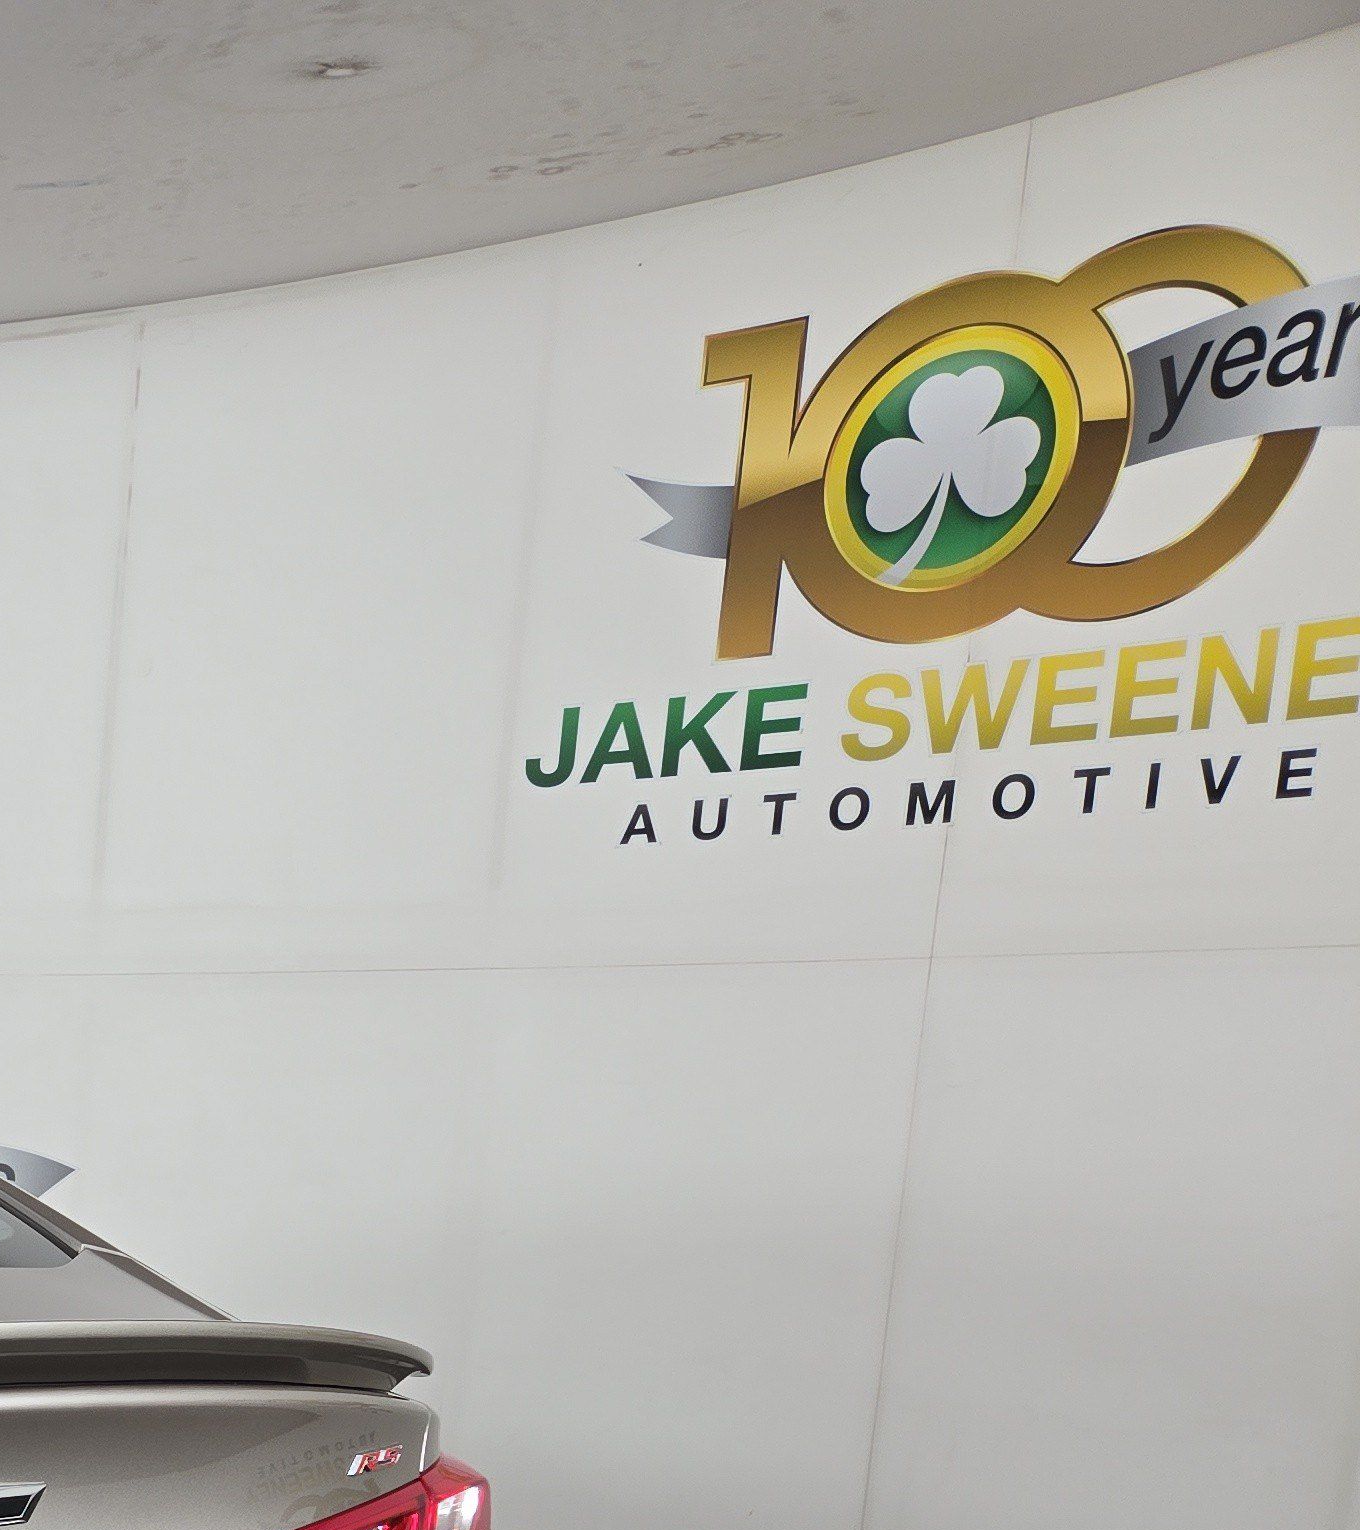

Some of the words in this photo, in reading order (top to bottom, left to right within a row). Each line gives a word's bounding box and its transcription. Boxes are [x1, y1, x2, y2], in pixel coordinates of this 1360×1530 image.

[702, 224, 1321, 661] 100
[1147, 301, 1360, 445] year
[525, 682, 809, 788] JAKE
[840, 616, 1360, 762] SWEENE
[620, 748, 1319, 845] AUTOMOTIVE
